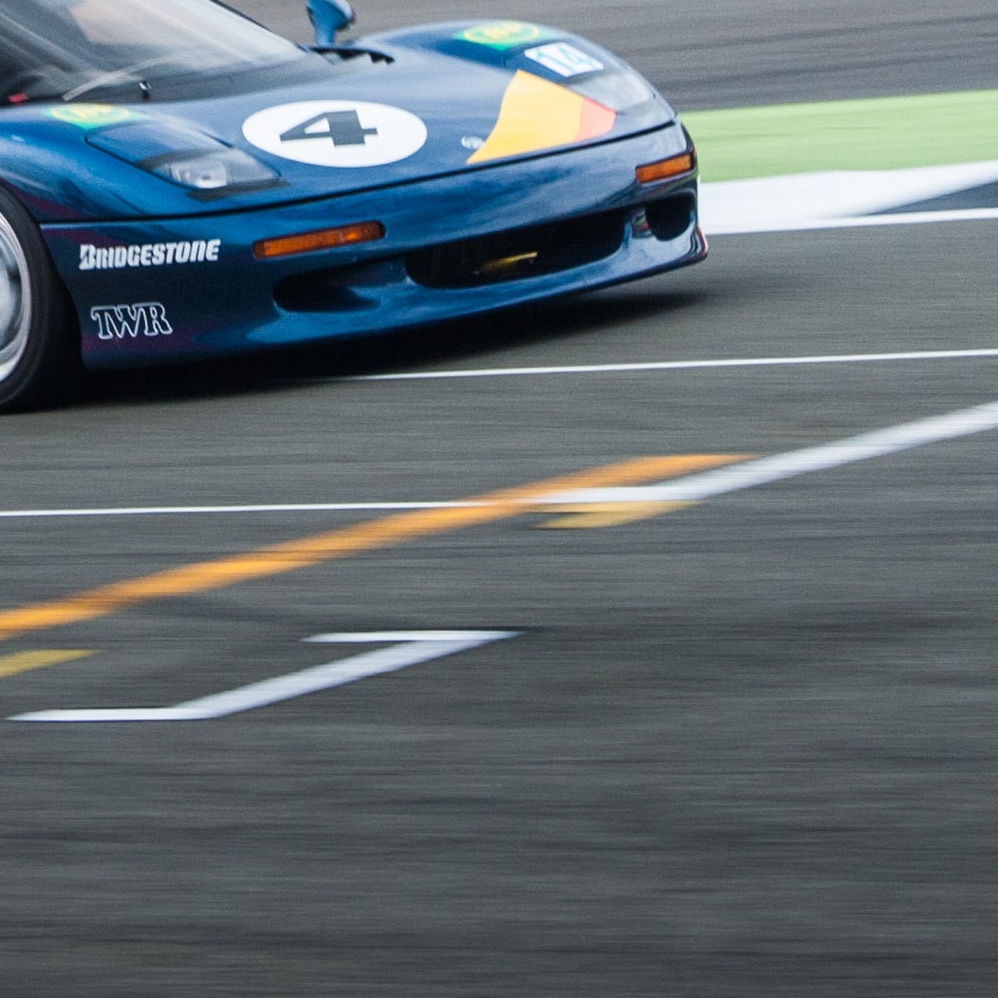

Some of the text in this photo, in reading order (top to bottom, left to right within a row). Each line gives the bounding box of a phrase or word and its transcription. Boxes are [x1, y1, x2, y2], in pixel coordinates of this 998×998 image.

[279, 109, 378, 147] 4
[79, 239, 221, 270] BRIDGESTONE
[90, 302, 173, 340] TWR
